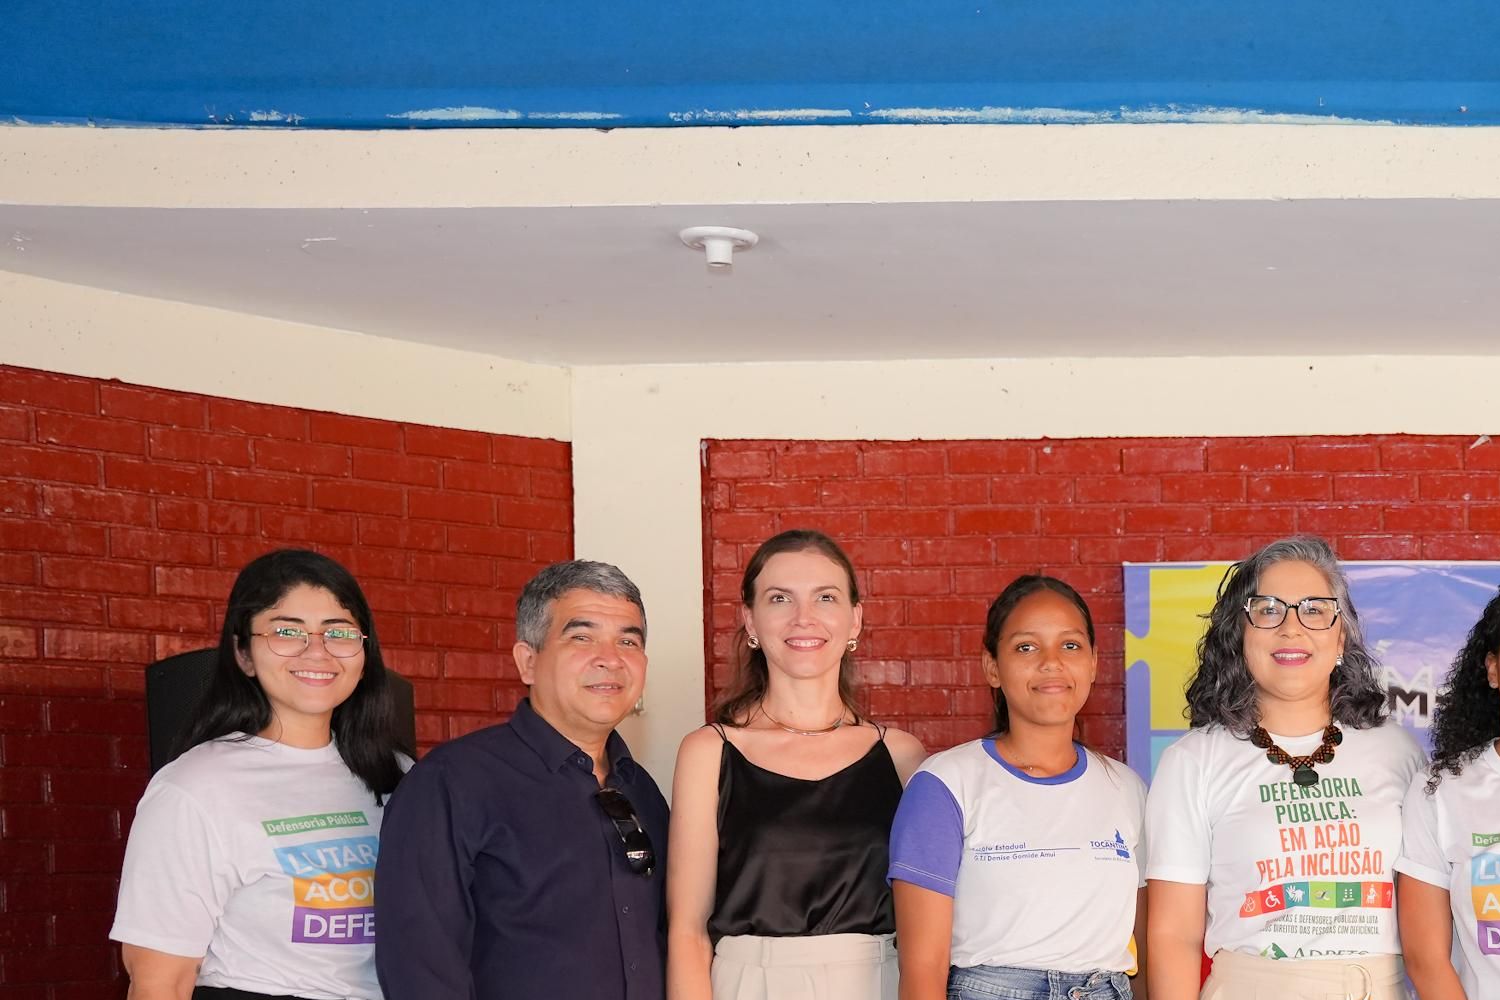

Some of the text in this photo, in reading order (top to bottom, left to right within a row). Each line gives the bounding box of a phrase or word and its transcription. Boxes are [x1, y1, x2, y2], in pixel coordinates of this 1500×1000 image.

[1259, 777, 1363, 803] DEFENSORIA
[266, 814, 366, 834] Defensoria Pública
[1275, 800, 1358, 825] PÚBLICA:
[995, 842, 1026, 851] Estadual
[1279, 820, 1361, 854] EM AÇÃO
[287, 843, 377, 875] LUTAR
[1255, 846, 1385, 884] PELA INCLUSÃO.
